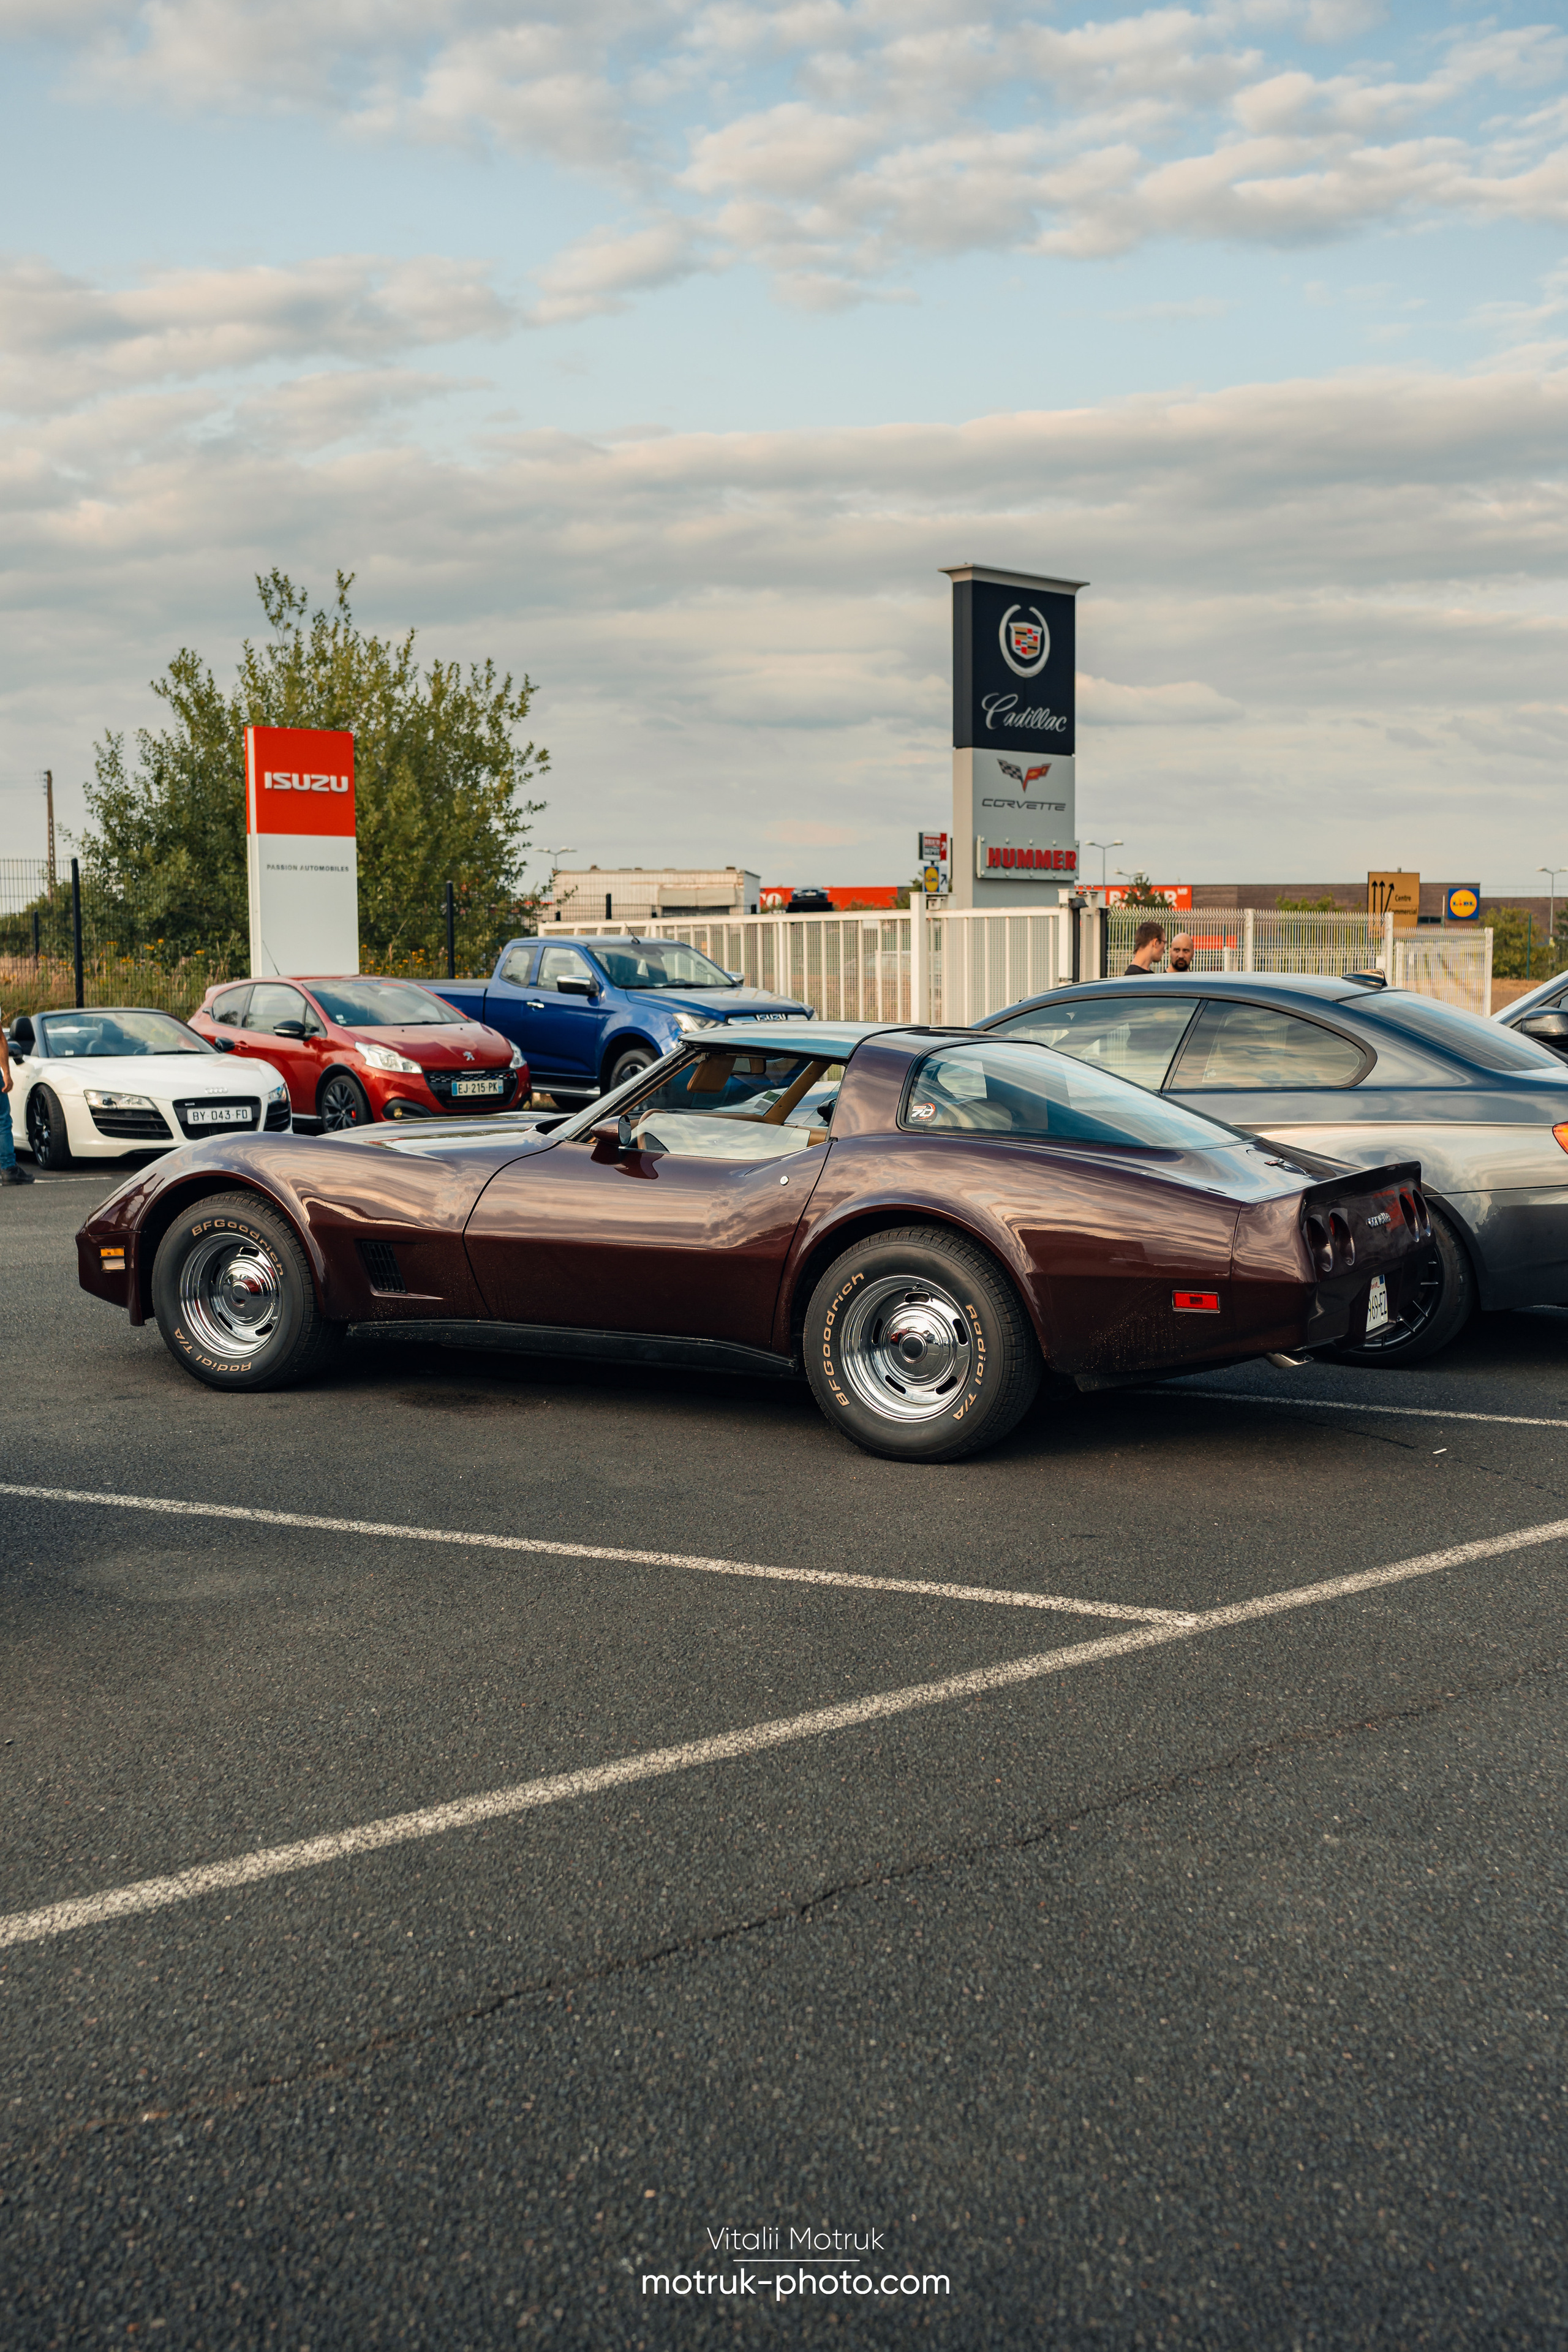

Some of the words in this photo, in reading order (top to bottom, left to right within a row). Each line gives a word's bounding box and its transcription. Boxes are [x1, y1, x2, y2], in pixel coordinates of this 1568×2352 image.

[981, 692, 1067, 732] Cadillac
[264, 771, 349, 793] ISUZU
[982, 798, 1066, 812] CORVETTE
[987, 848, 1077, 870] HUMMER
[192, 1219, 284, 1276] BFGoodrich
[174, 1328, 193, 1354] T/A
[823, 1272, 864, 1406] BFGoodrich
[966, 1304, 986, 1386] Radial
[195, 1355, 252, 1373] Radial
[952, 1393, 977, 1420] T/A
